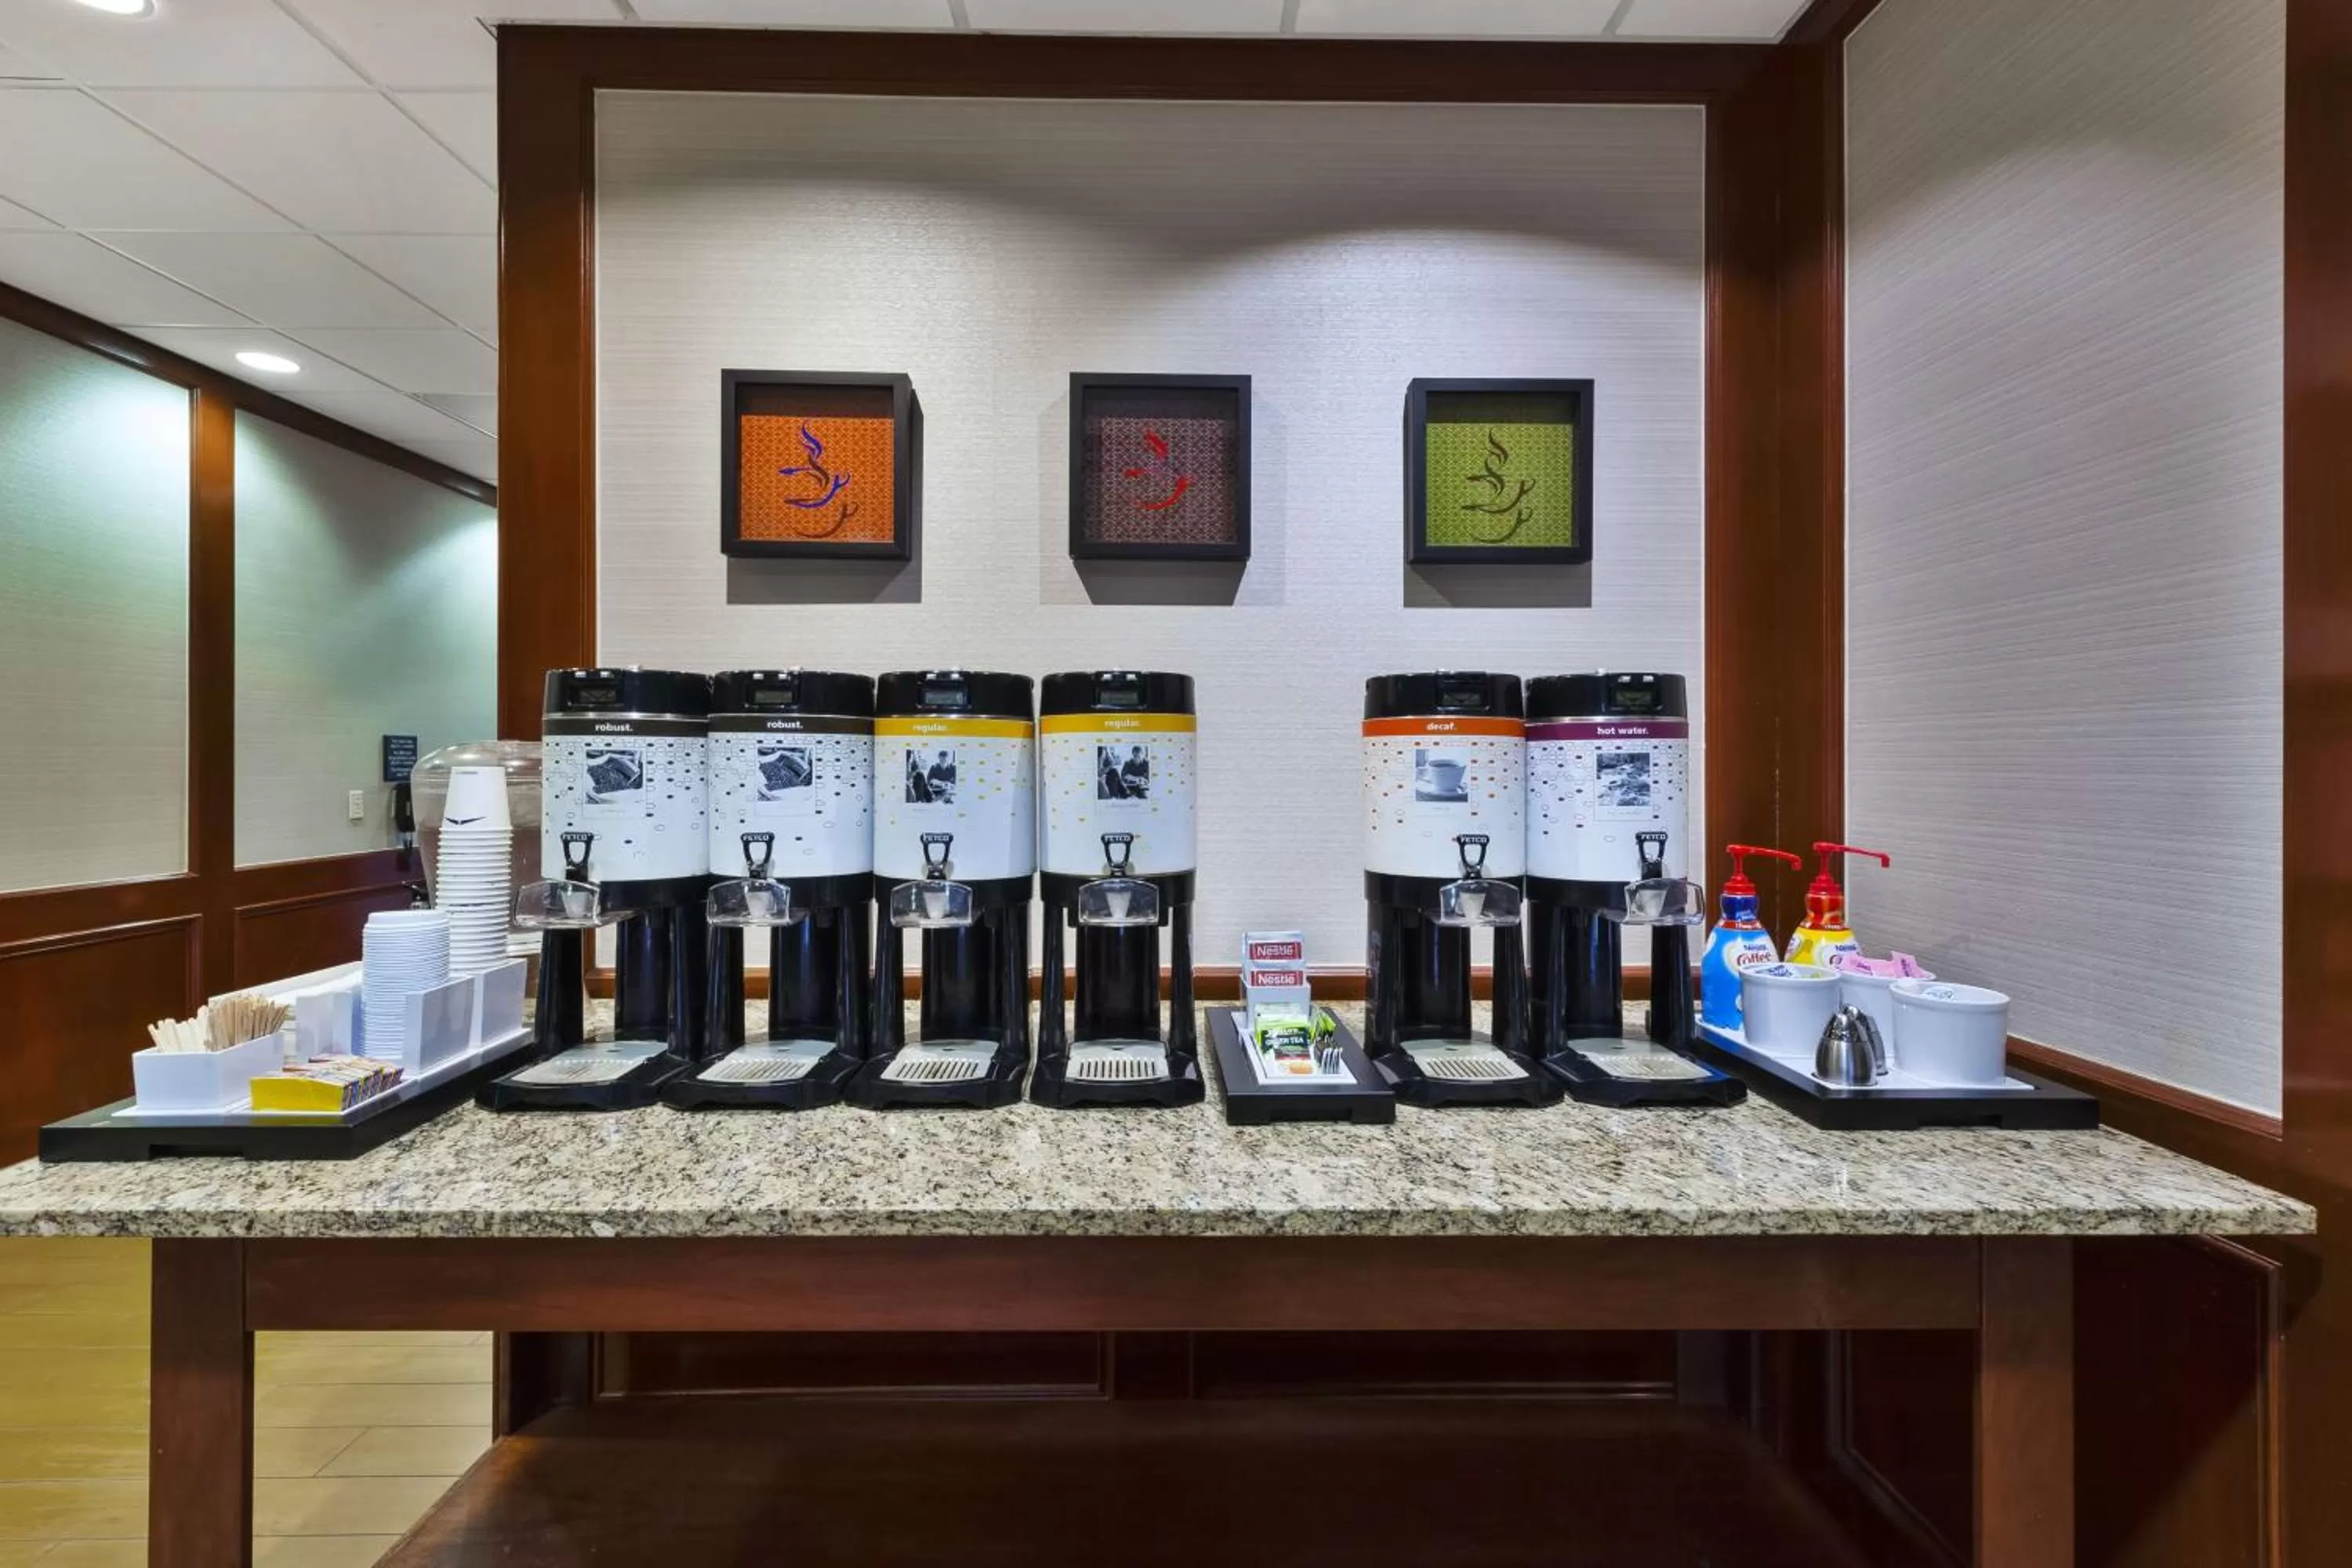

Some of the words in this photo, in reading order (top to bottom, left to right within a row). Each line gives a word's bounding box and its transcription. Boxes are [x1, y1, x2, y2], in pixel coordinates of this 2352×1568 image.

[595, 722, 633, 731] robust.
[767, 719, 804, 728] robust.
[1426, 721, 1457, 731] decaf.
